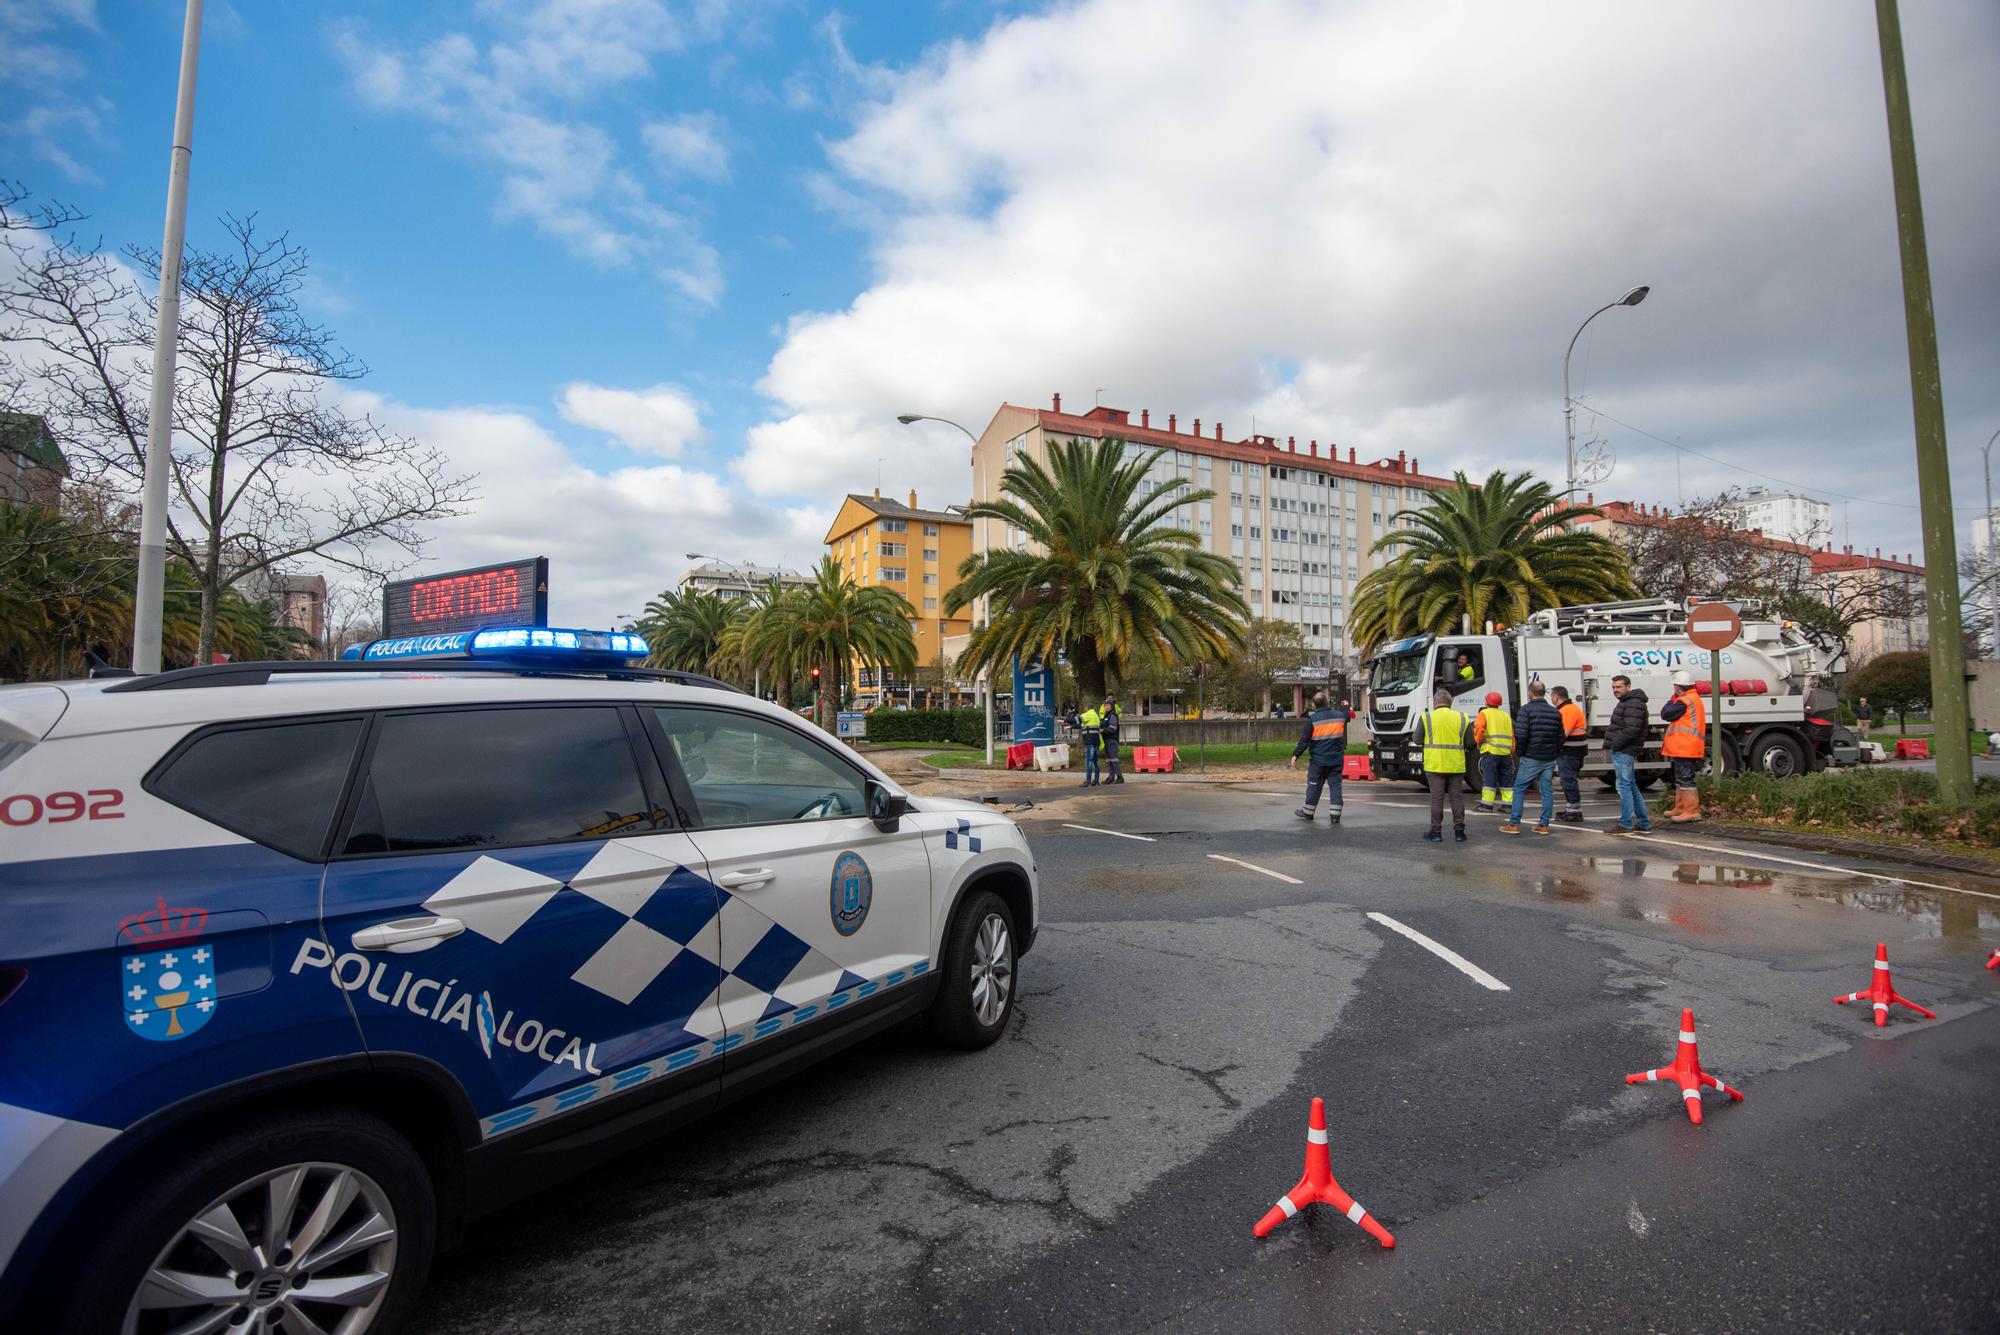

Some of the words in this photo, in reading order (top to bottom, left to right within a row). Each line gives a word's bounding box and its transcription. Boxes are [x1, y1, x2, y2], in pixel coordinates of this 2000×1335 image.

[412, 568, 518, 621] CORTADA
[421, 635, 462, 652] LOCAL
[1617, 650, 1683, 667] sacyr
[1687, 652, 1733, 670] aga
[1024, 661, 1045, 706] ELV
[0, 789, 125, 826] 092
[290, 937, 472, 1031] POLICÍA
[497, 1010, 602, 1076] LOCAL
